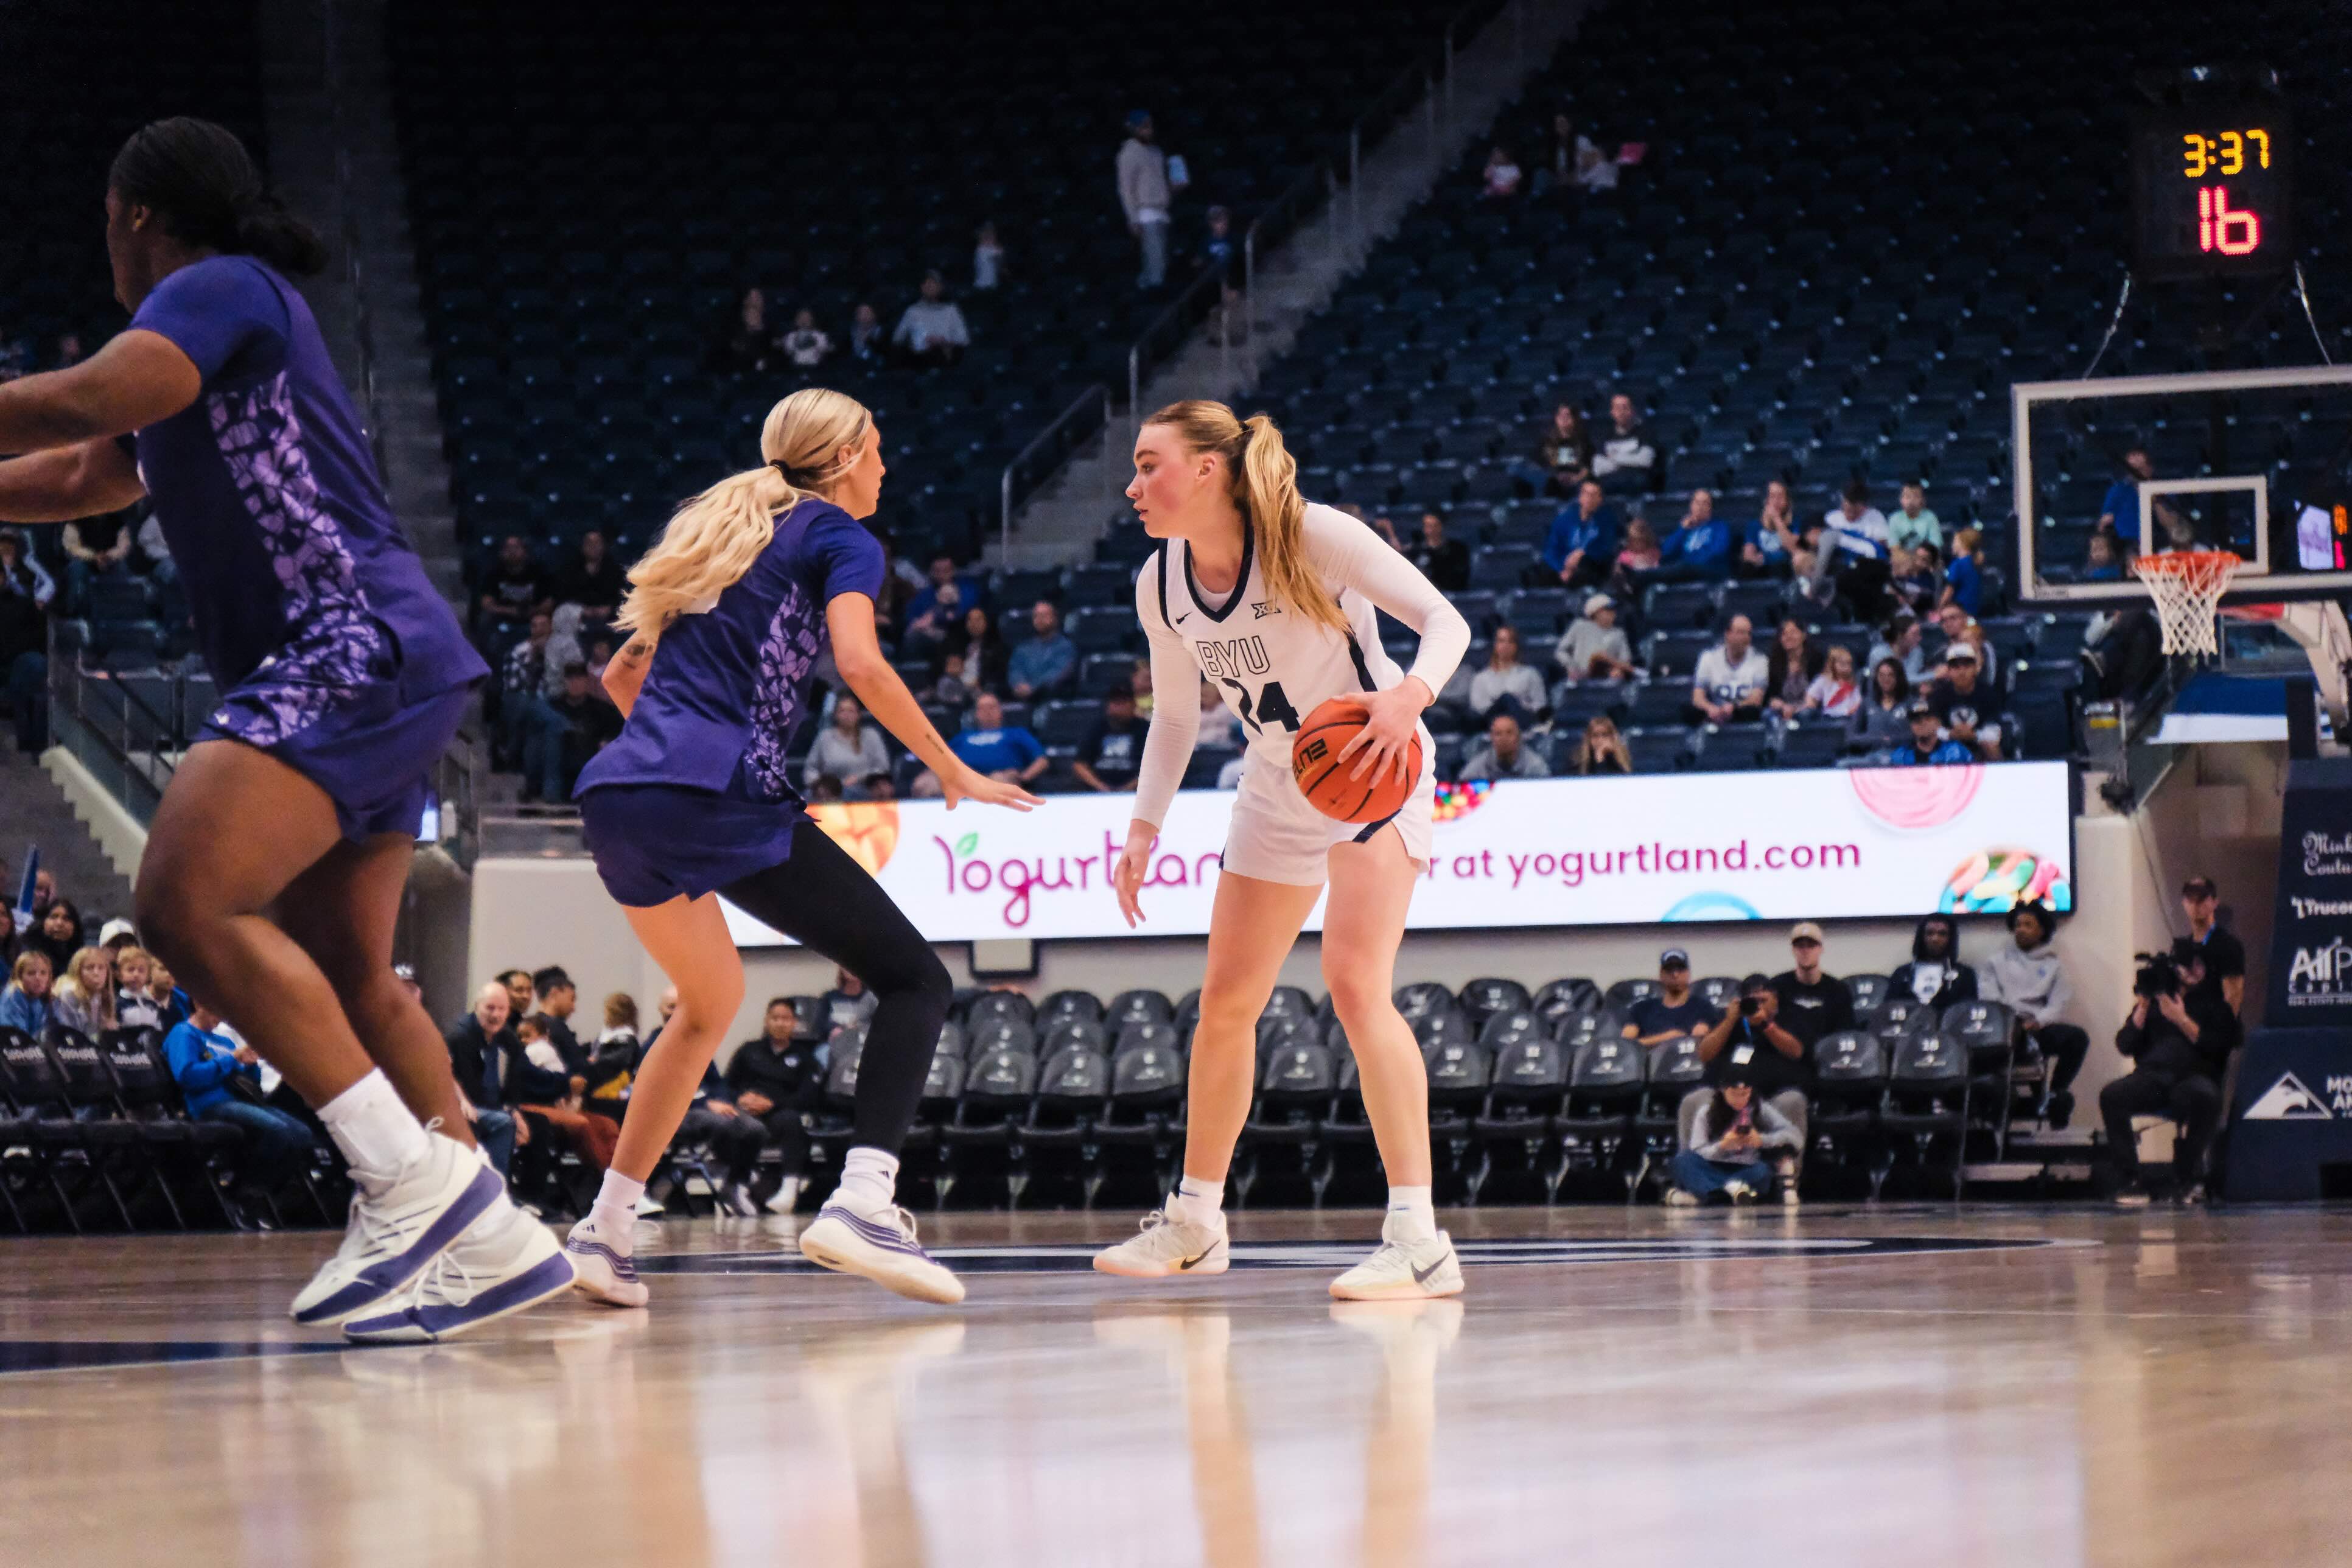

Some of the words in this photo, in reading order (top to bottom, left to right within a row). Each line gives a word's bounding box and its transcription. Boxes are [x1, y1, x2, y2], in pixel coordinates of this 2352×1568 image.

[2183, 129, 2270, 178] 3:37
[2199, 186, 2260, 255] 16
[1196, 635, 1270, 677] BYU
[934, 829, 1221, 928] Yogurtan
[1453, 849, 1494, 878] at
[1507, 839, 1861, 889] yogurtland.com
